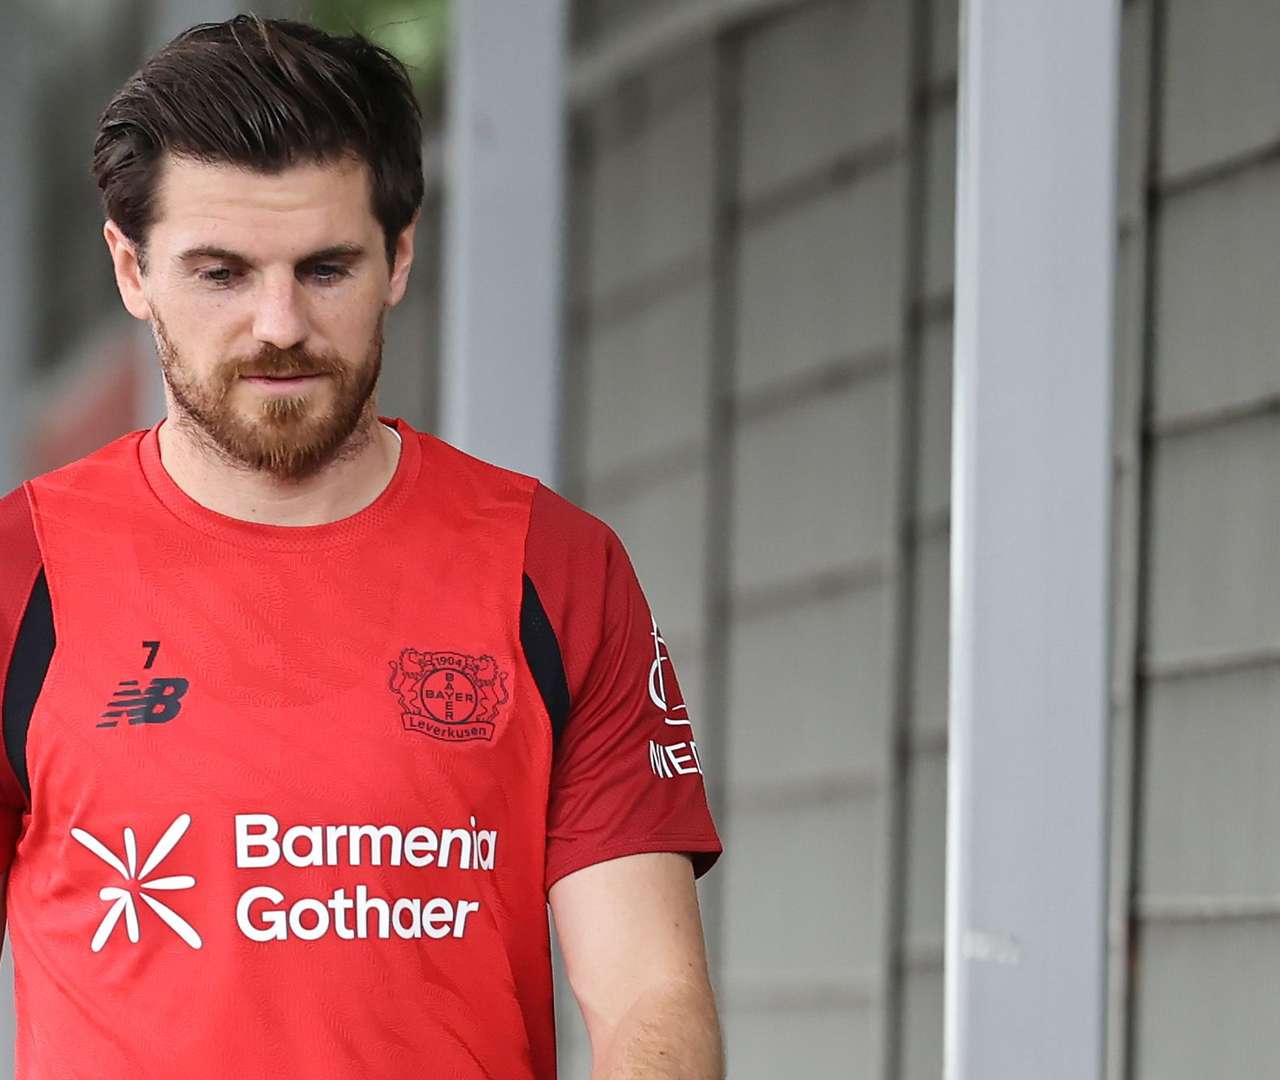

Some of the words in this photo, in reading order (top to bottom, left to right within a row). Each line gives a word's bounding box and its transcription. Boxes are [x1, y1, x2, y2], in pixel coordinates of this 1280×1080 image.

[142, 641, 161, 669] 7
[435, 656, 462, 667] 1904
[426, 689, 474, 702] BAYER
[409, 716, 487, 739] Leverkusen
[234, 813, 498, 871] Barmenia
[236, 885, 480, 941] Gothaer
